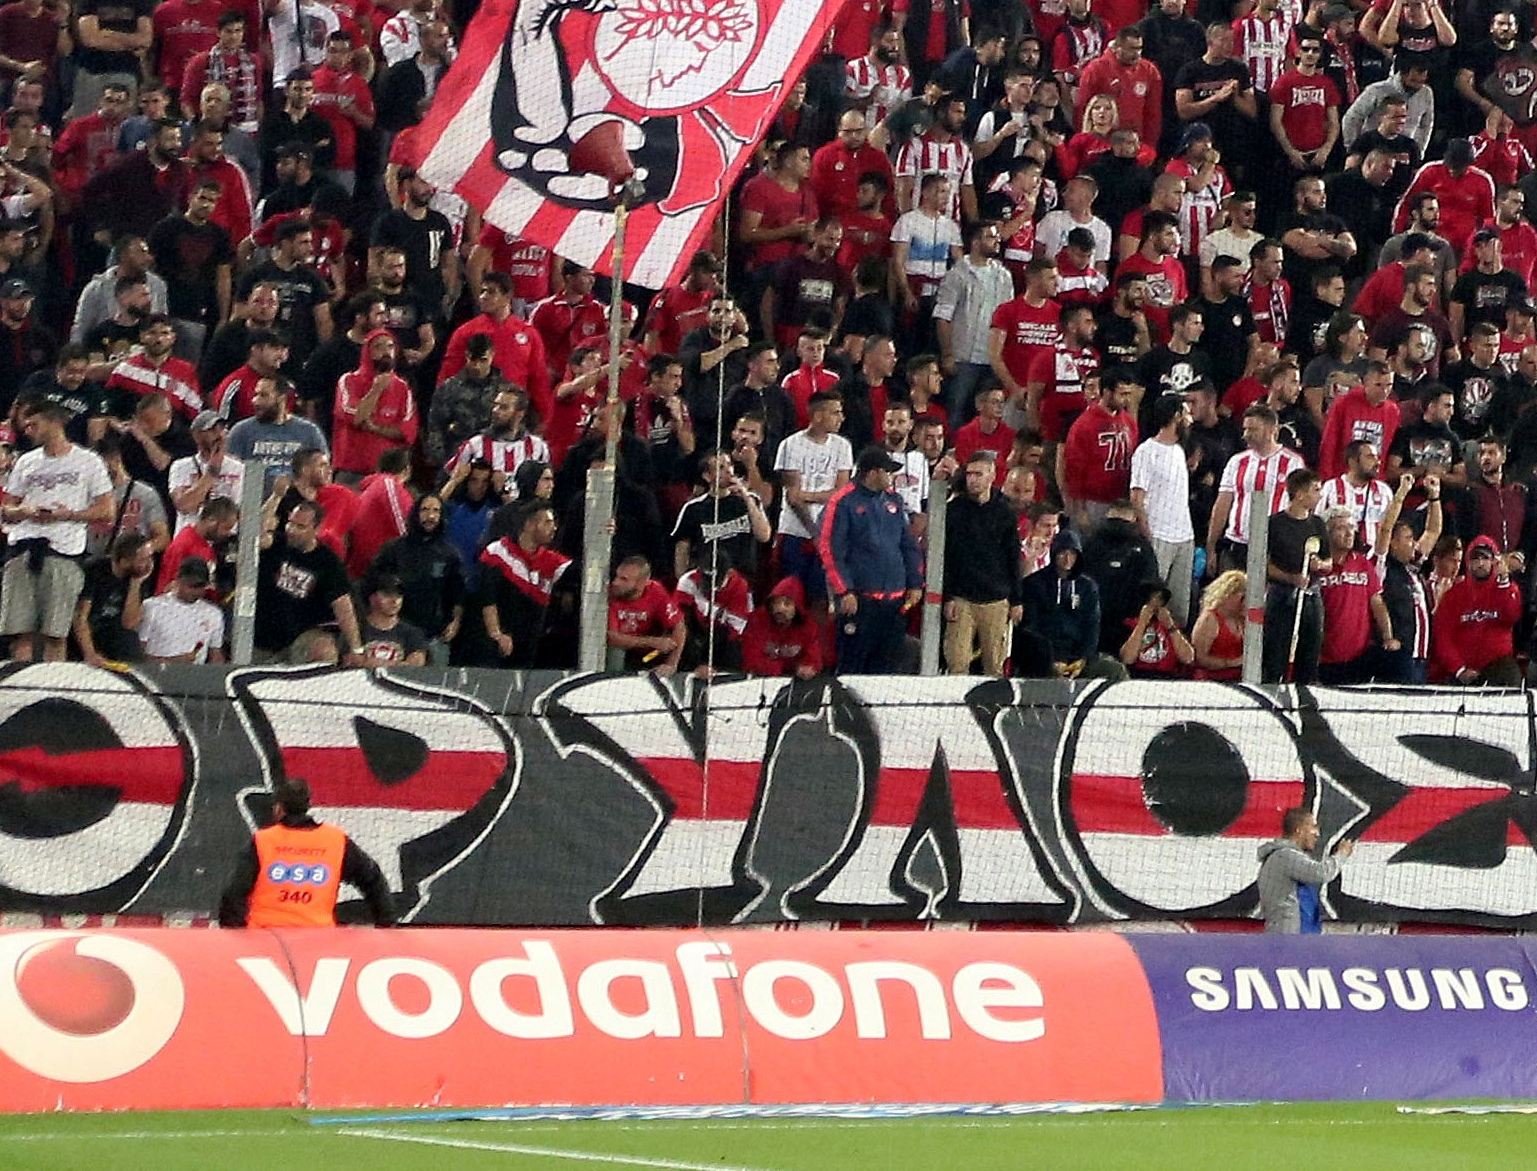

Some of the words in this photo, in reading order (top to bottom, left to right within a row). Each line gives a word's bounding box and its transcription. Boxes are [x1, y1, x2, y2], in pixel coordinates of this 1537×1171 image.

[1098, 431, 1131, 472] 71
[276, 890, 313, 905] 340
[236, 939, 1045, 1044] vodafone
[1186, 964, 1529, 1013] SAMSUNG
